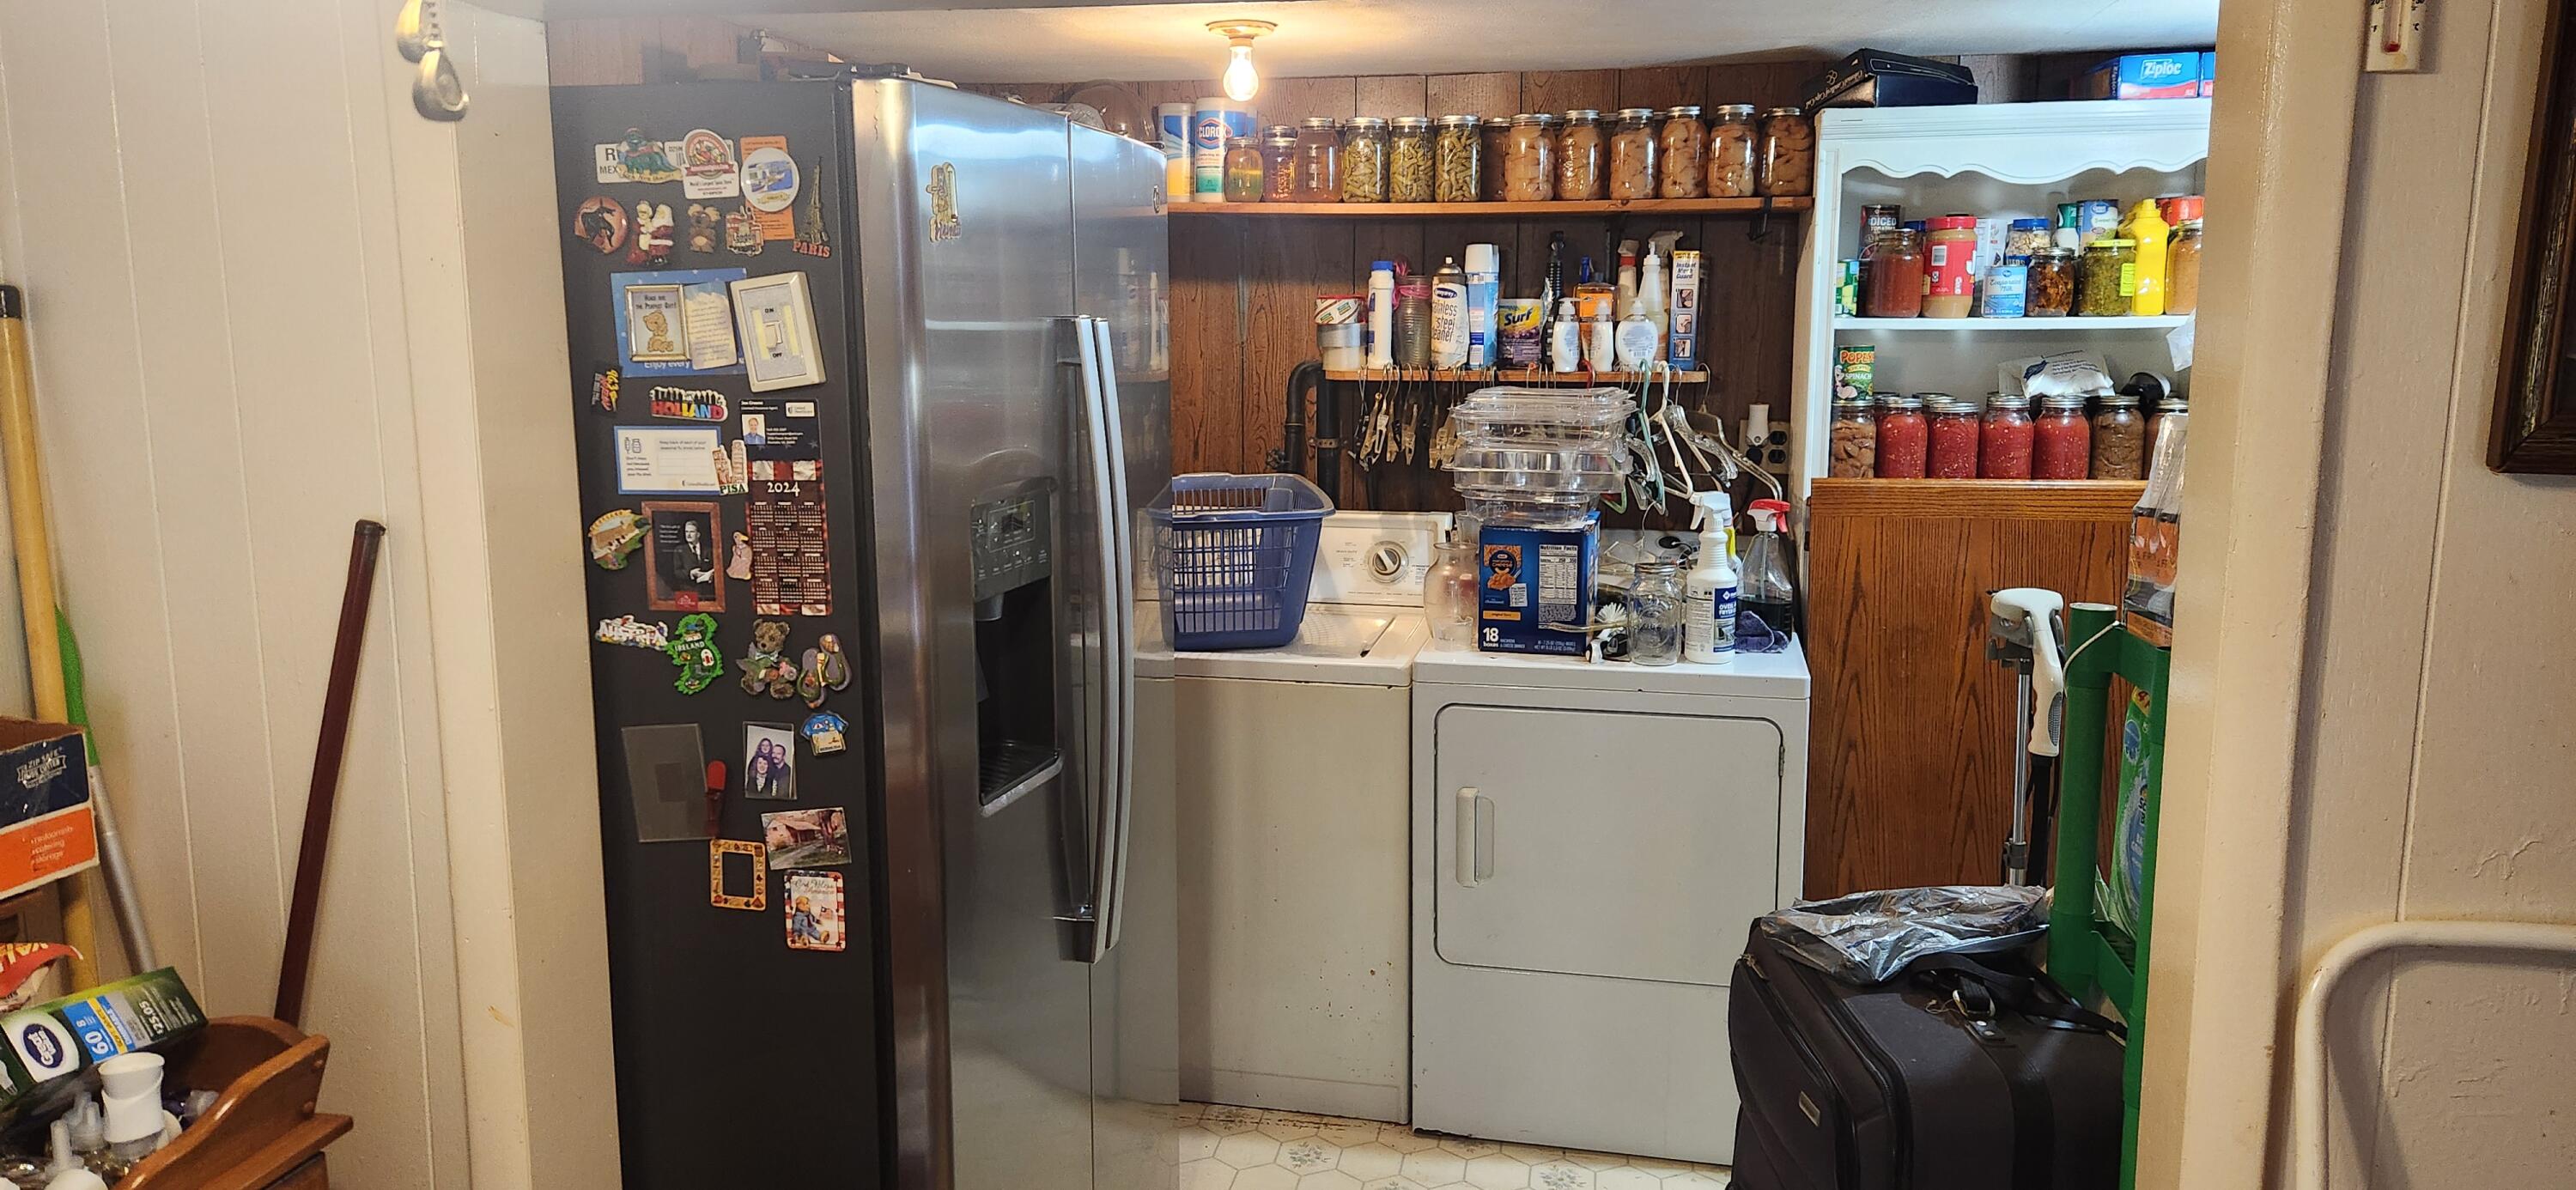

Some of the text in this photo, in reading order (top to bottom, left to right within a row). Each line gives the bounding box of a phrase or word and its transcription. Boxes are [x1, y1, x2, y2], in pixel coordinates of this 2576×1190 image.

[2143, 61, 2183, 78] Ziploc
[1870, 216, 1897, 226] DICED
[793, 240, 831, 258] PARIS
[1437, 315, 1455, 331] steel
[1504, 307, 1534, 326] Surf
[644, 361, 666, 370] Enjoy
[650, 400, 726, 419] HOLLAND
[720, 483, 746, 494] PISA
[767, 482, 800, 496] 2024
[1483, 628, 1499, 642] 18
[675, 641, 706, 652] IRELAND
[27, 756, 40, 769] ZIP
[139, 1000, 165, 1035] $25.05
[84, 1030, 108, 1055] 60
